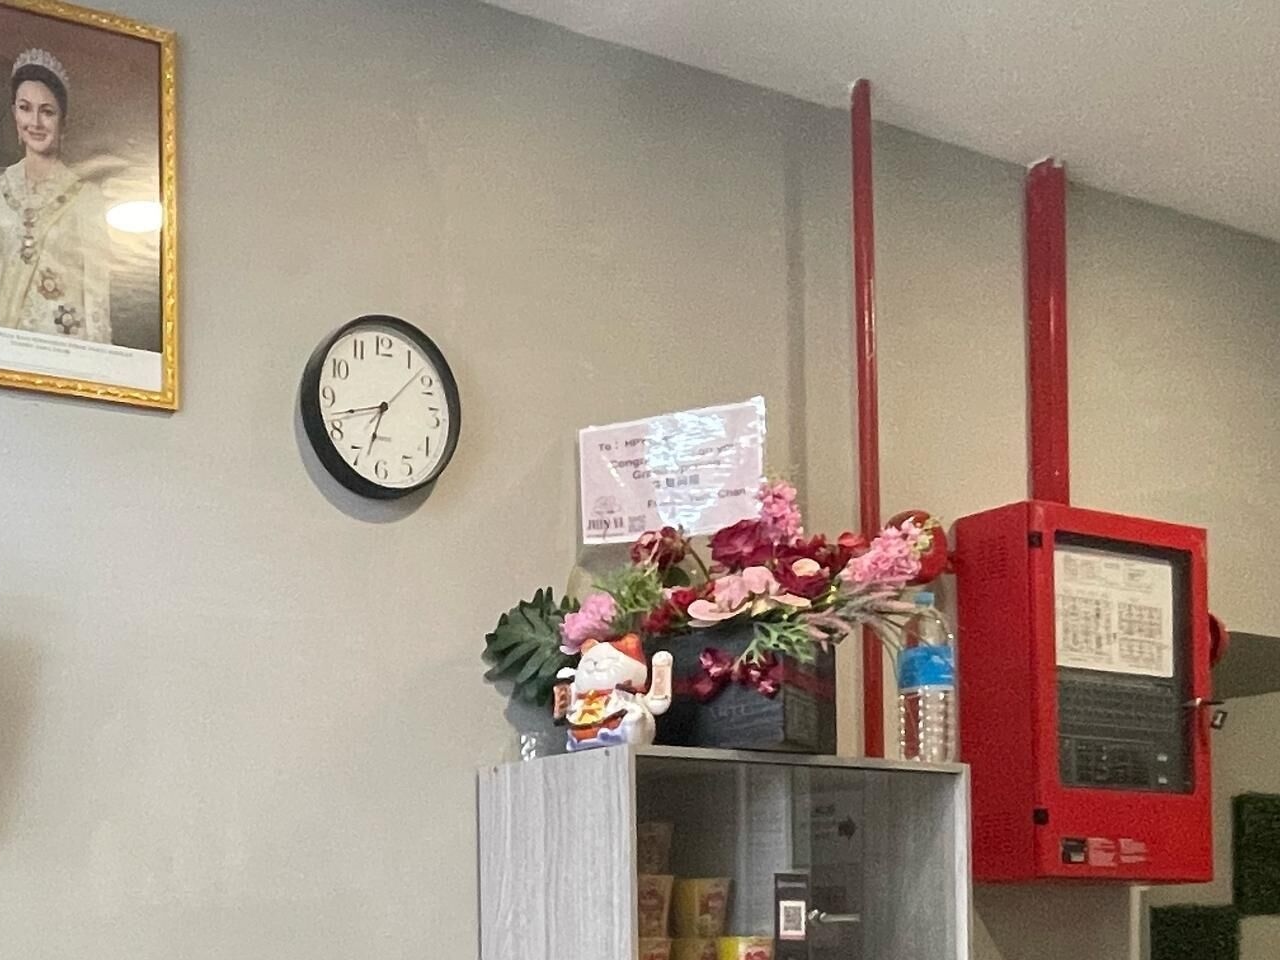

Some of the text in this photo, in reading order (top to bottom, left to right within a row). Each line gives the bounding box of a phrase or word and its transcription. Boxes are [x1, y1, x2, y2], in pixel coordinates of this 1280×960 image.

[353, 339, 364, 360] 11
[376, 335, 393, 358] 12
[332, 358, 350, 380] 10
[407, 350, 412, 369] 1
[420, 375, 433, 395] 2
[322, 386, 336, 408] 9
[428, 407, 440, 429] 3
[330, 420, 344, 440] 8
[351, 445, 363, 466] 7
[402, 455, 413, 476] 5
[375, 460, 388, 479] 6
